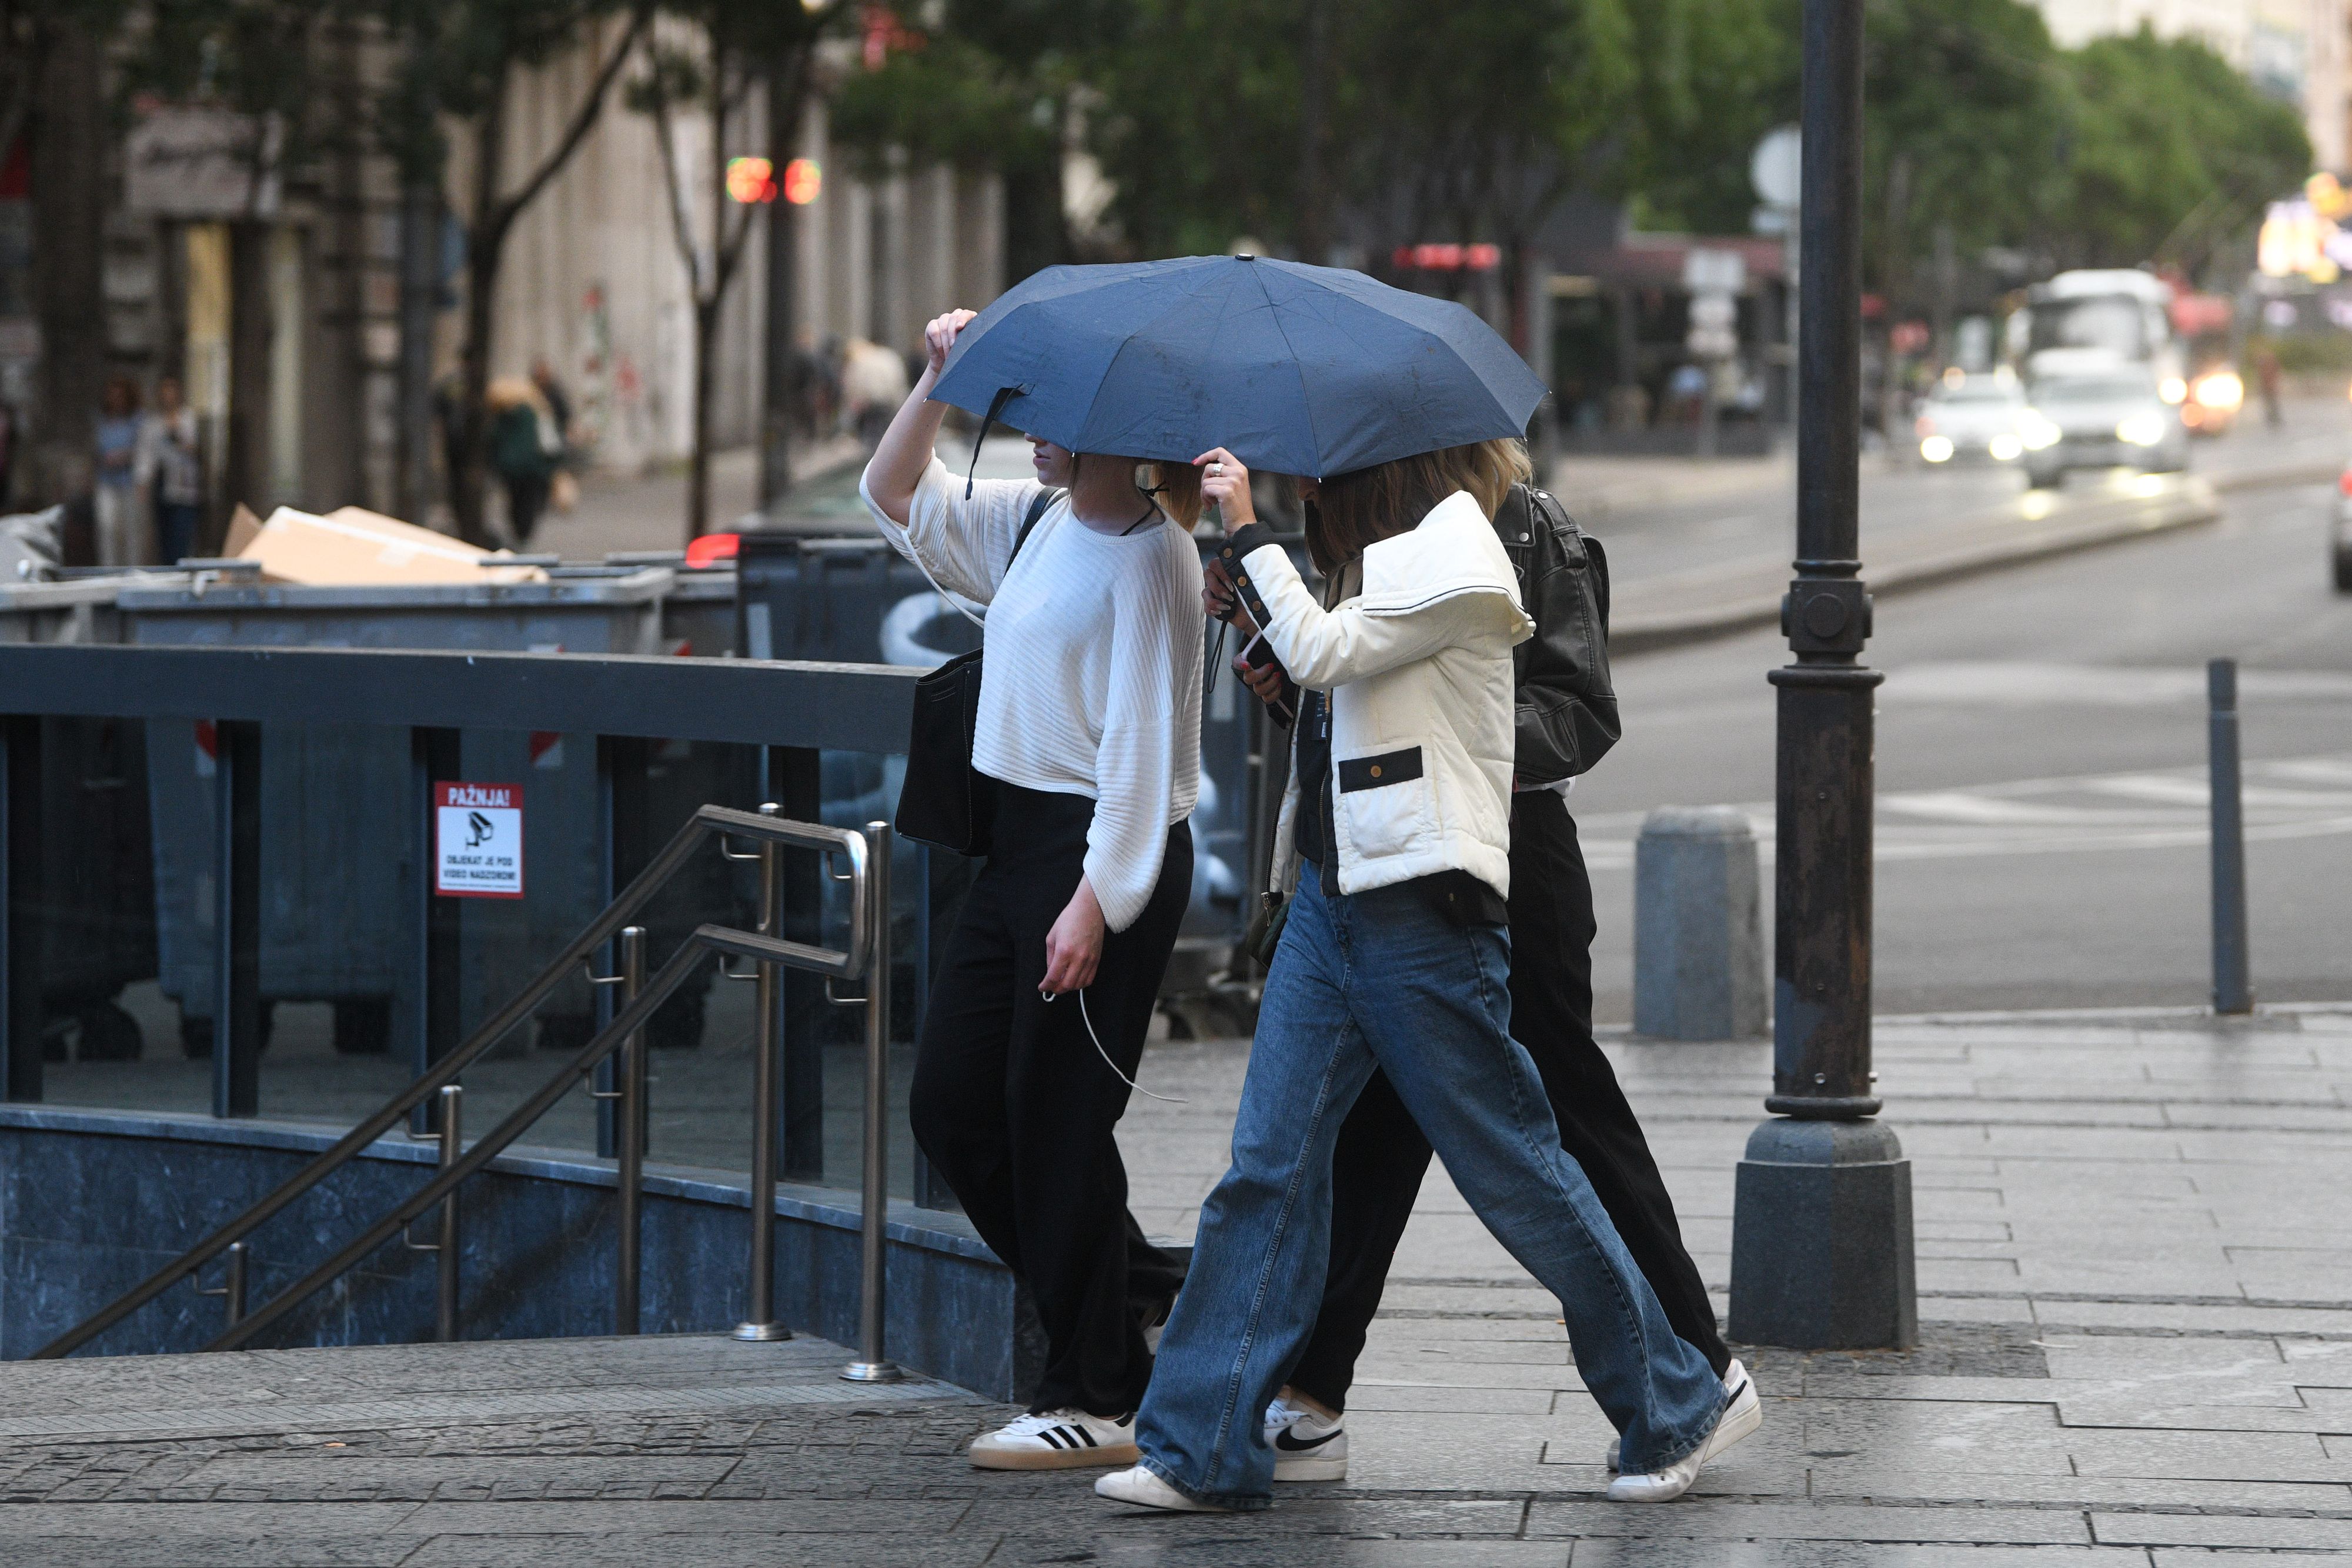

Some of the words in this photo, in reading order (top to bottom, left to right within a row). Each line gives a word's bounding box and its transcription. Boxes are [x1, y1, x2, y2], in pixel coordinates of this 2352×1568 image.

[449, 784, 510, 807] PAŽNJA!
[447, 855, 482, 865] OBJEKAT
[485, 856, 493, 865] JE
[496, 856, 512, 866] POD
[443, 870, 467, 878] VIDEO
